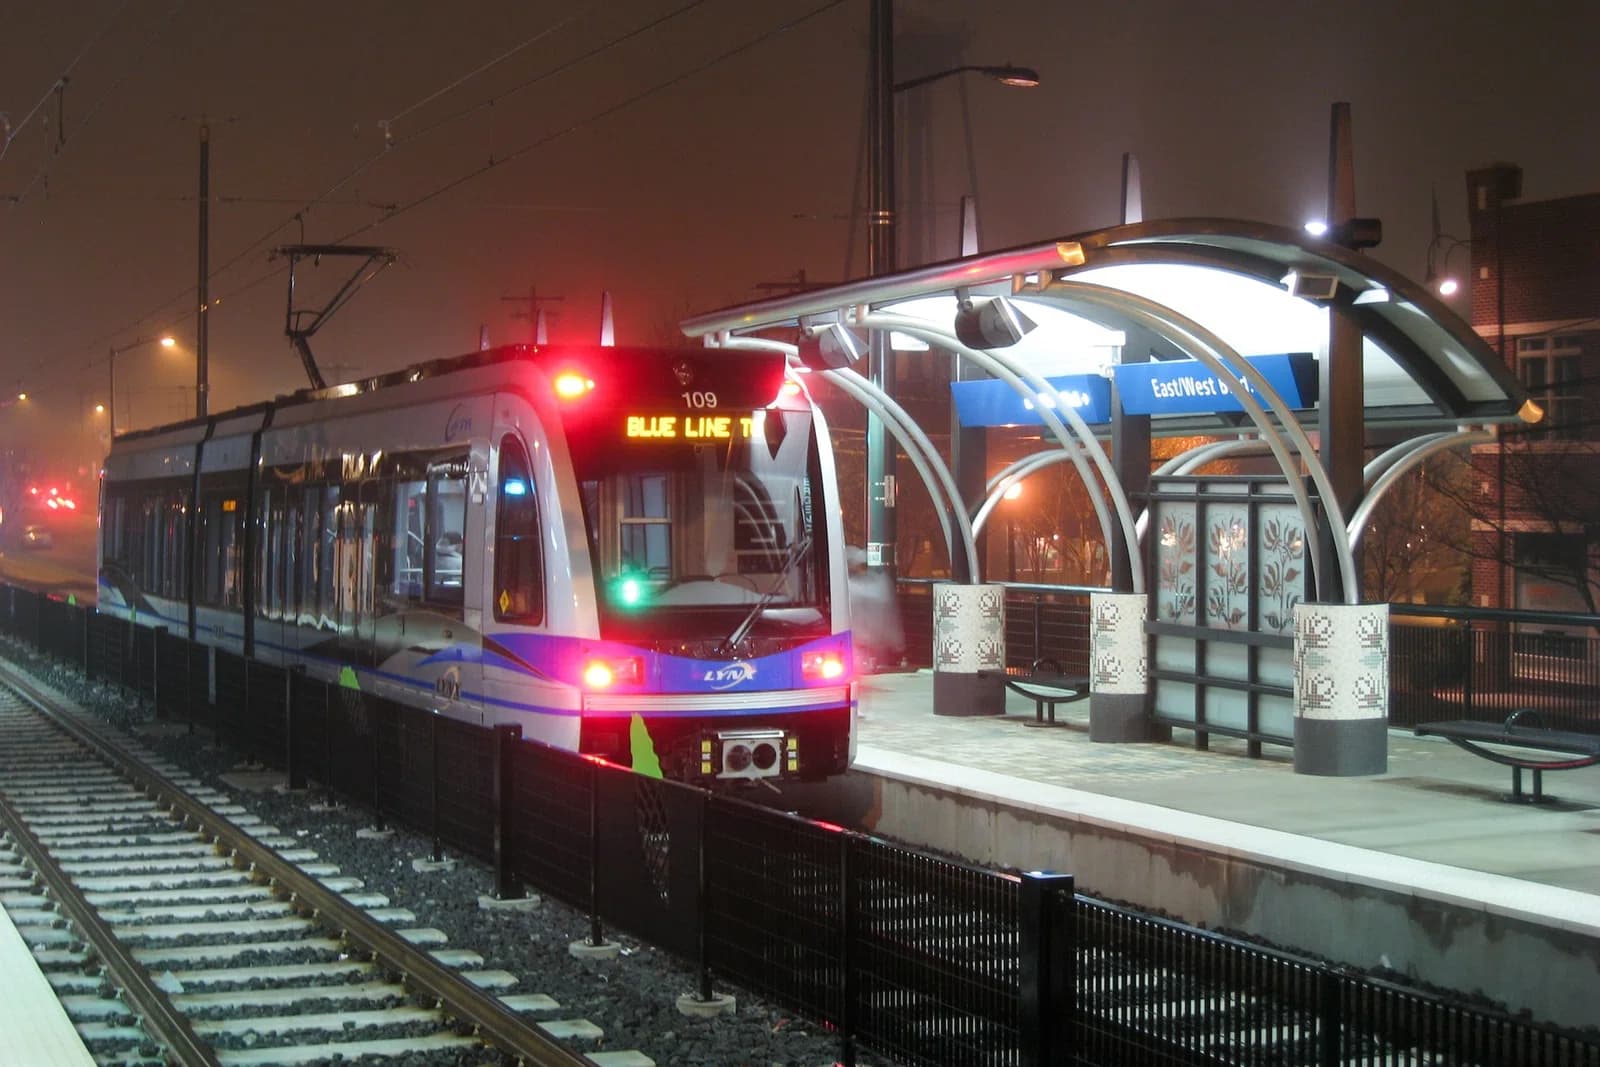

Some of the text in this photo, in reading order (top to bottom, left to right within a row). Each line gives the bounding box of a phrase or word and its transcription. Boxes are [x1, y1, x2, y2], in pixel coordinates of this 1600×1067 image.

[1151, 376, 1217, 398] East/West
[682, 391, 718, 409] 109
[627, 416, 676, 438] BLUE
[685, 416, 731, 438] LINE
